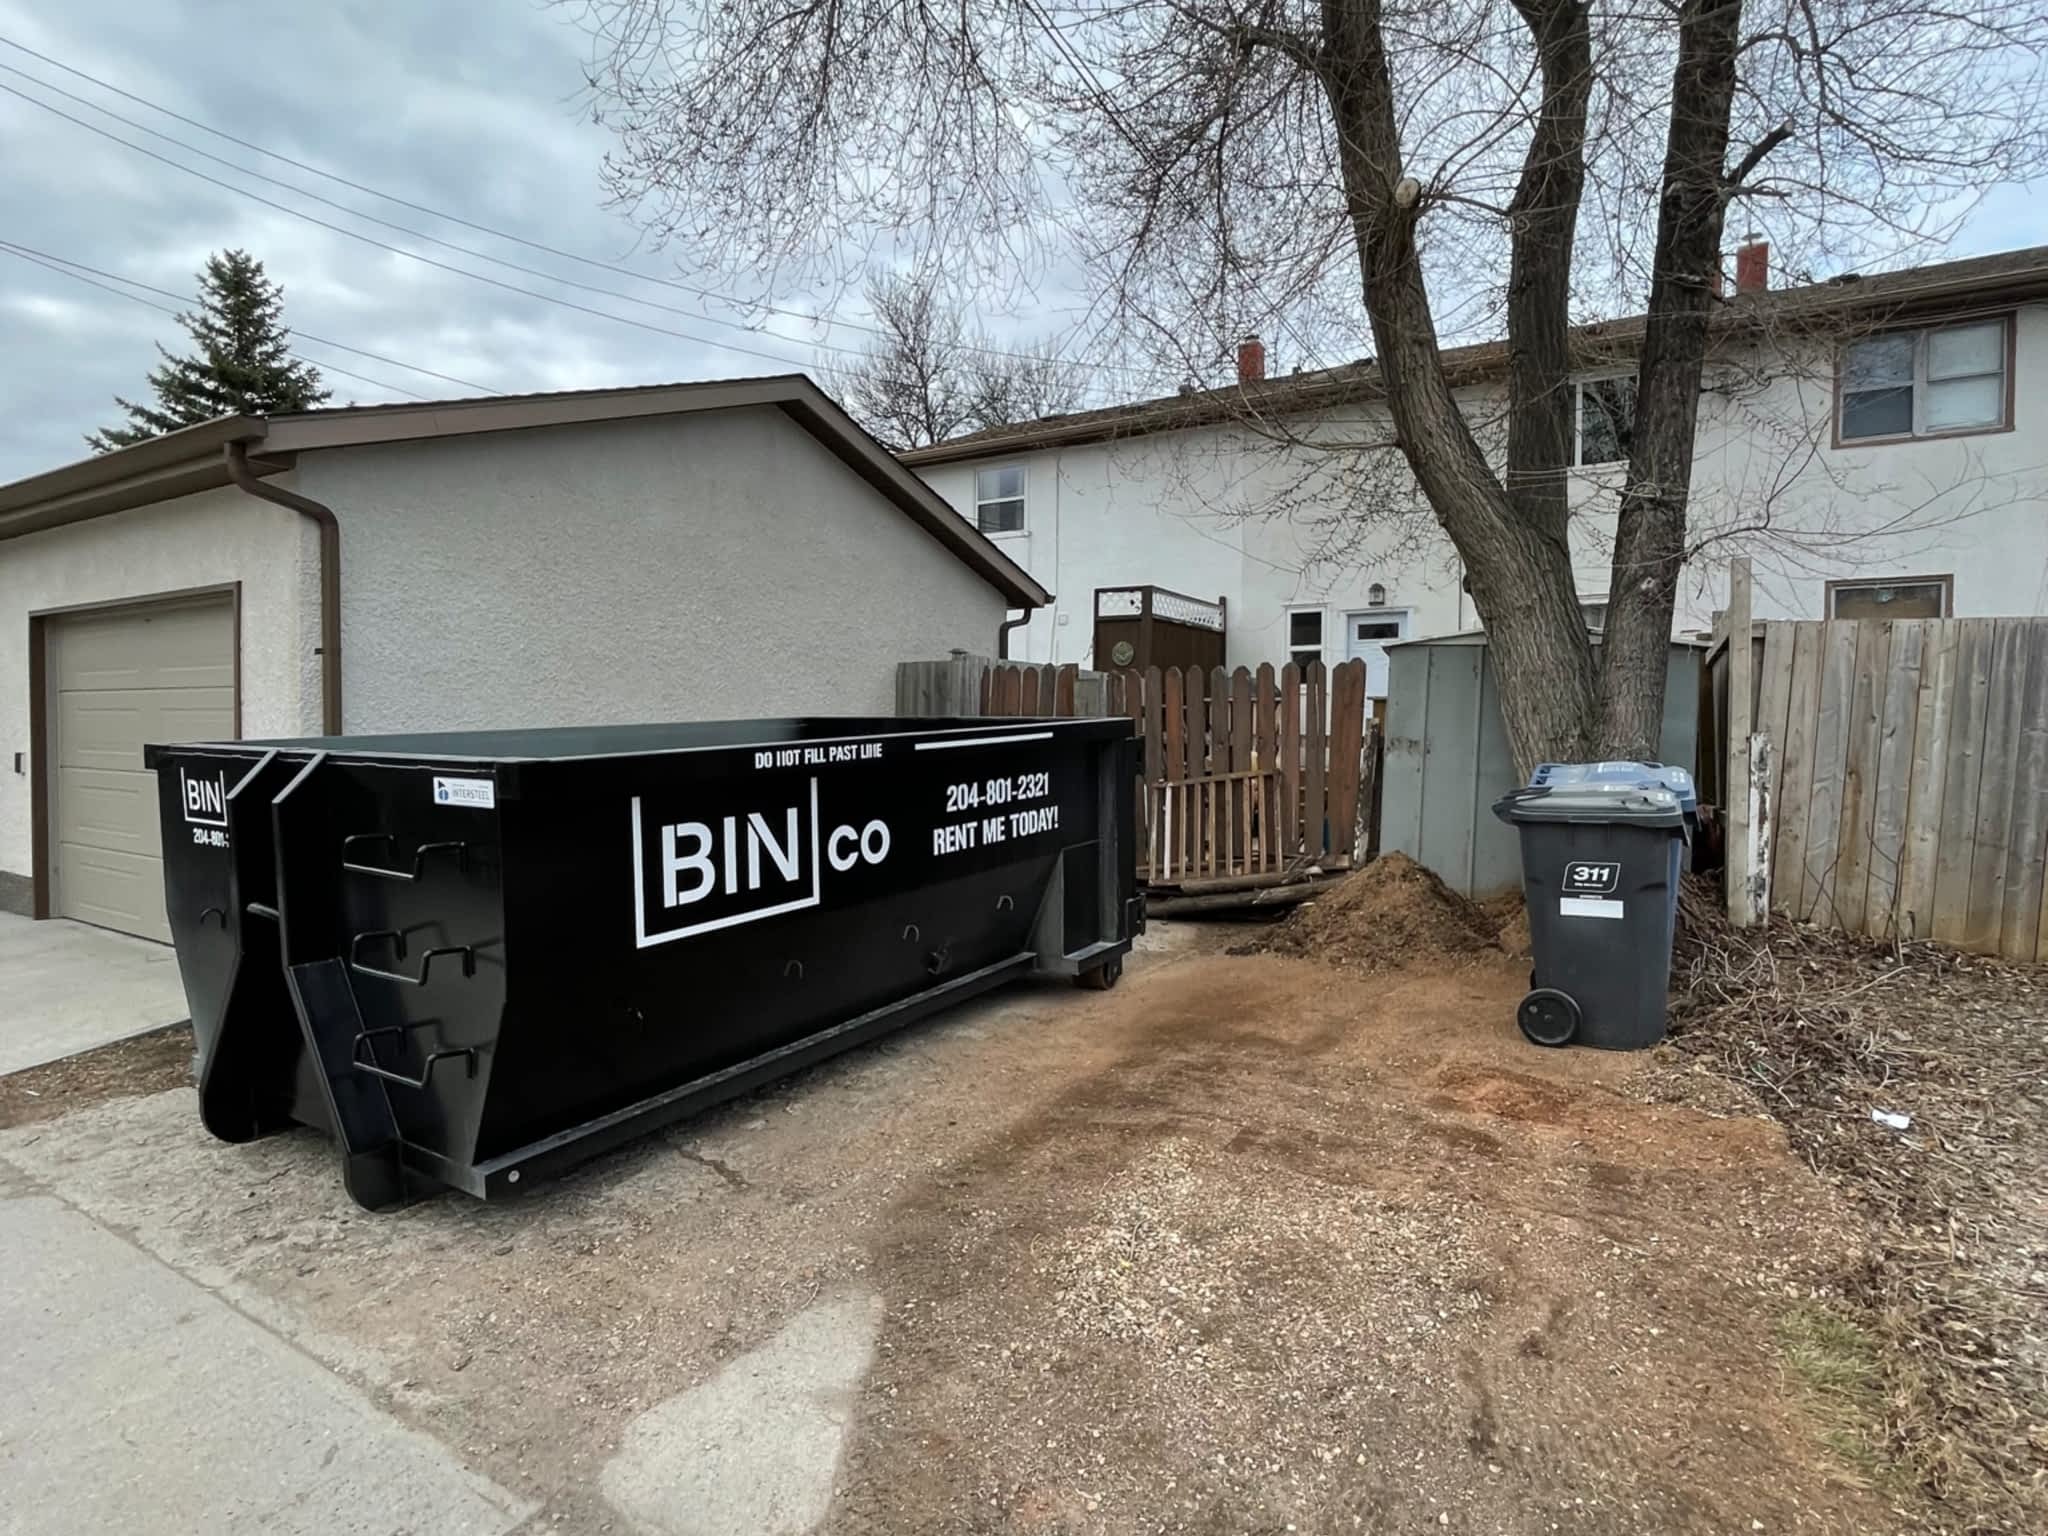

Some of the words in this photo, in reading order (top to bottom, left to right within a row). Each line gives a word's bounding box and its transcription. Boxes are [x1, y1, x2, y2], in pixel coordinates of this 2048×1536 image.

[755, 752, 773, 769] DO
[777, 749, 801, 767] NOT
[804, 747, 826, 764] FILL
[829, 745, 858, 762] PAST
[860, 743, 882, 759] LINE
[187, 779, 222, 813] BIN
[946, 772, 1049, 812] 204-801-2321
[933, 822, 978, 856] RENT
[983, 816, 1006, 845] ME
[1009, 805, 1058, 838] TODAY!
[662, 807, 798, 908] BIN
[1573, 866, 1610, 881] 311
